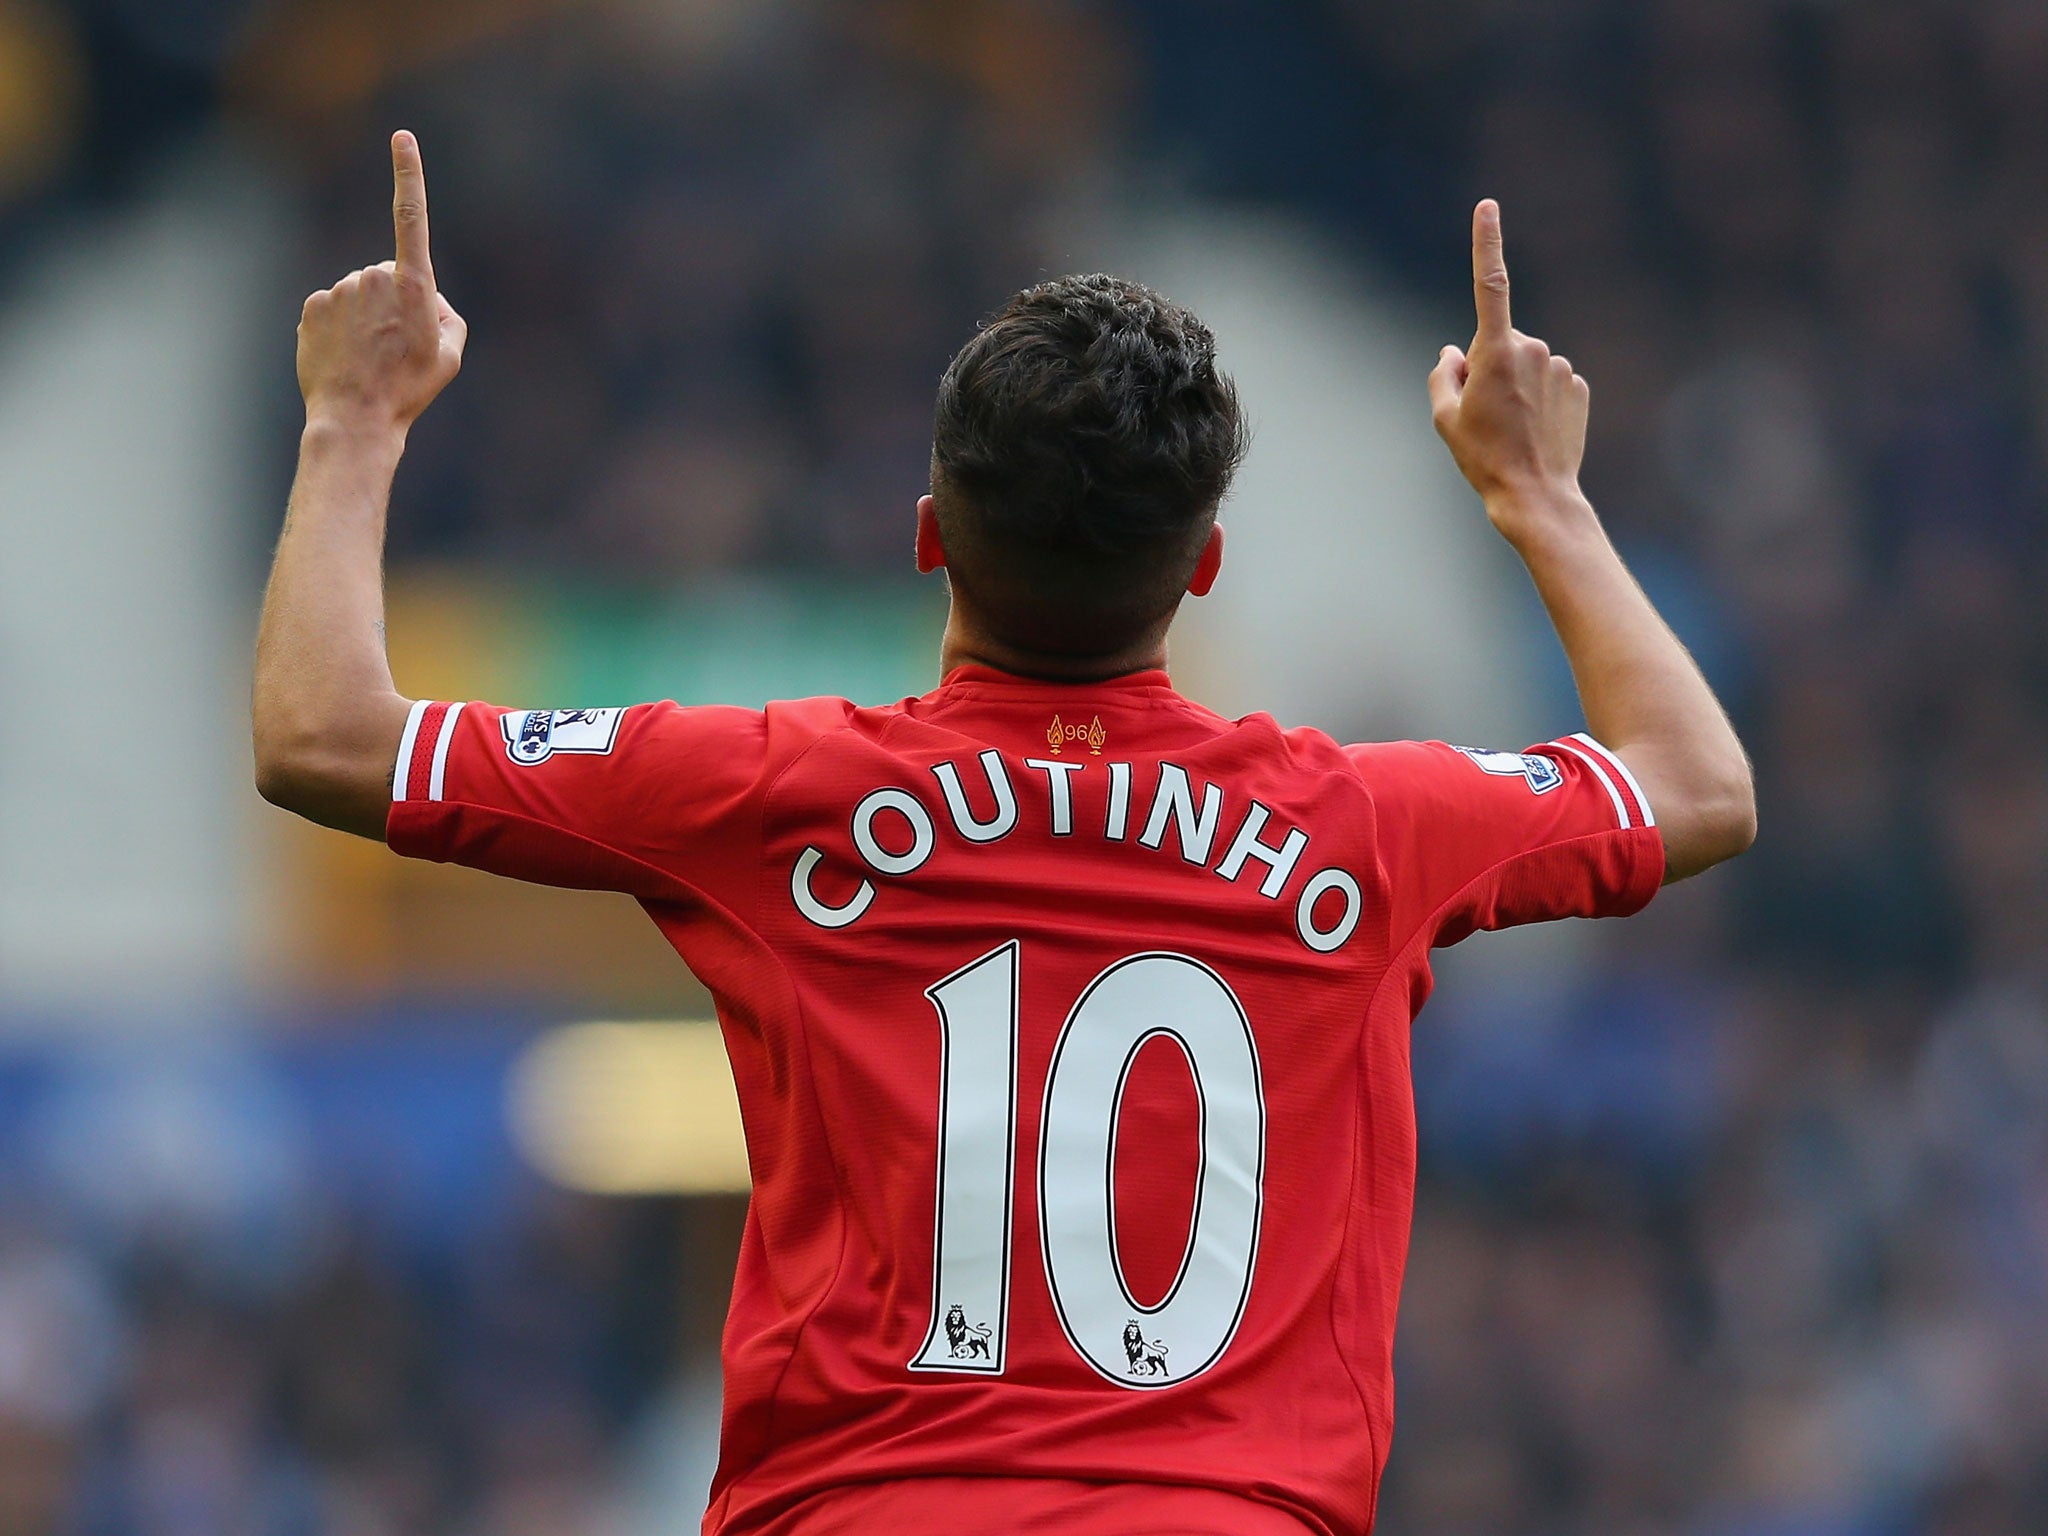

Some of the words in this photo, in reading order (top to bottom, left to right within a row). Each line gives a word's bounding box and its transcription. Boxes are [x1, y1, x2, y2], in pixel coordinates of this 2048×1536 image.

[1064, 724, 1088, 741] 96
[790, 749, 1363, 954] COUTINHO
[907, 938, 1267, 1391] 10
